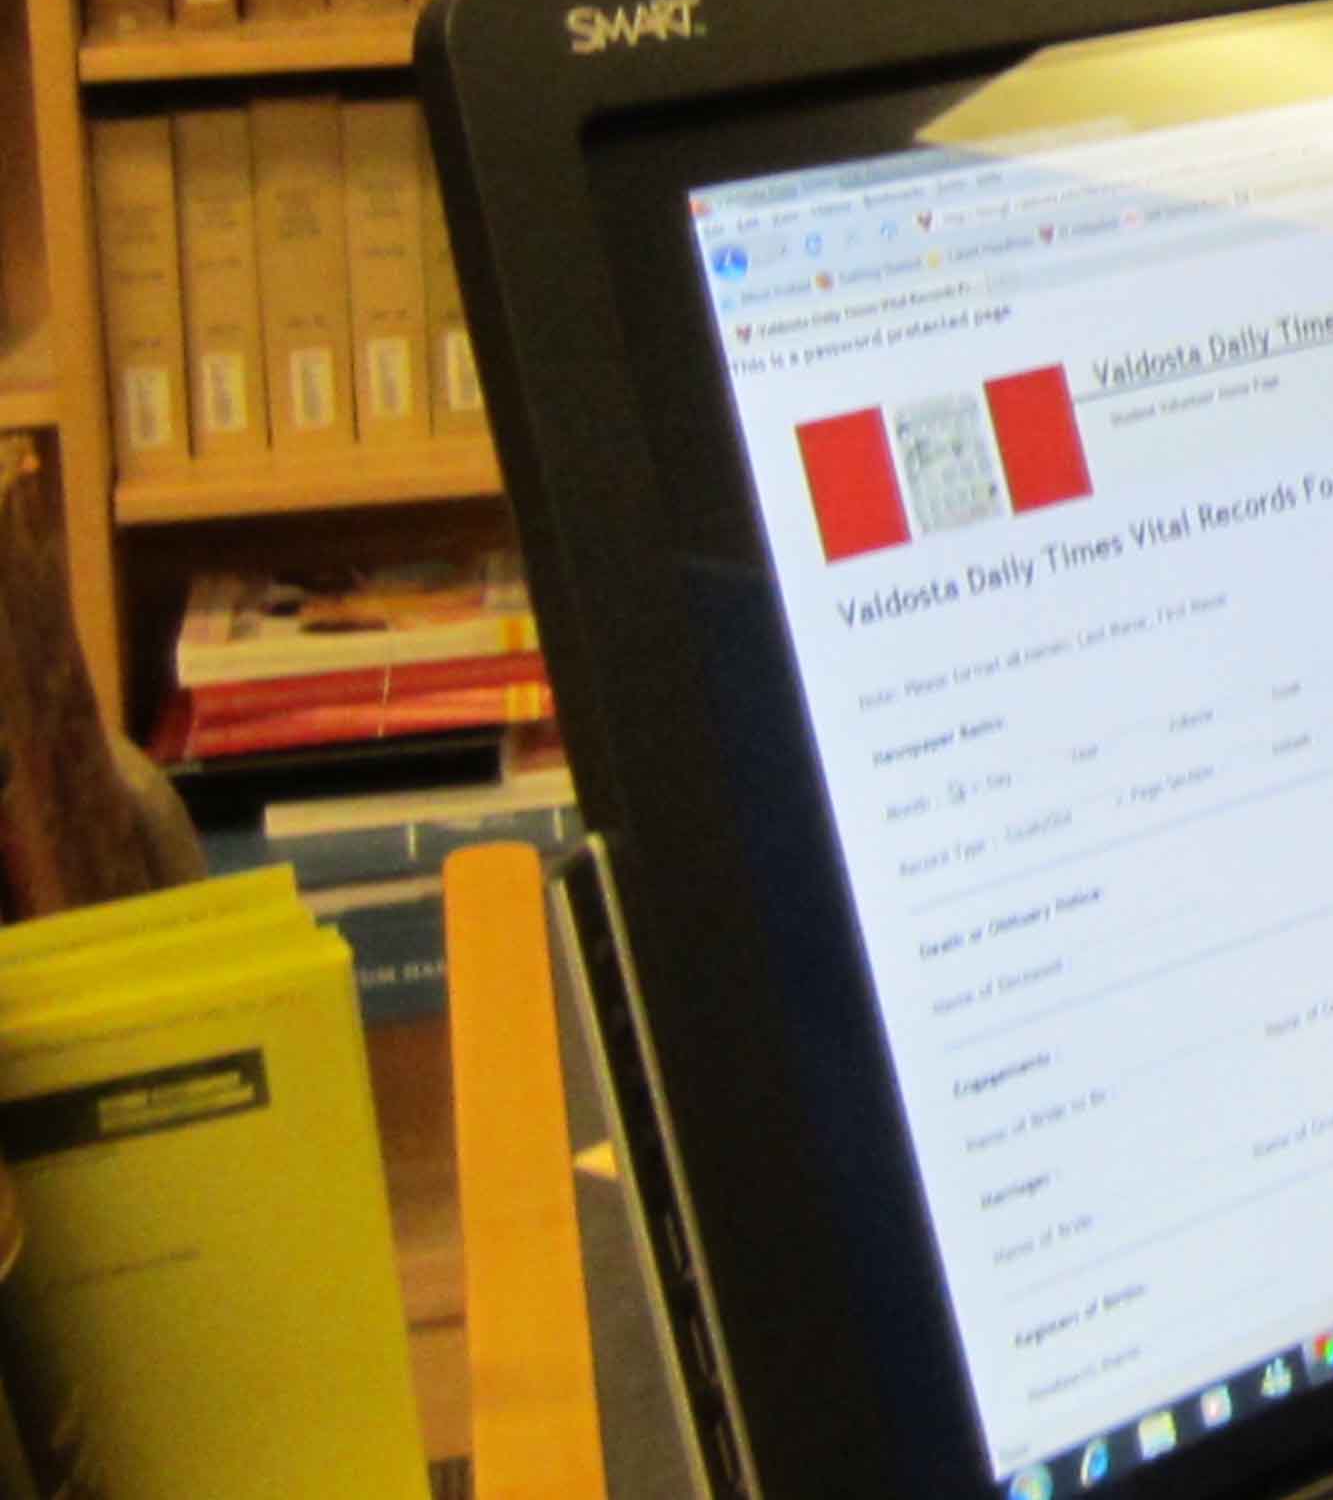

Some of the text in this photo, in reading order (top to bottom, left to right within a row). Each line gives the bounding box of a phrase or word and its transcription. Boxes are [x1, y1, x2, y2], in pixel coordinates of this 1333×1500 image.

[803, 328, 882, 363] password
[886, 311, 968, 344] protected
[1092, 346, 1201, 387] Valdosta
[1207, 326, 1275, 365] Daily
[837, 580, 959, 626] Valdosta
[965, 556, 1034, 594] Daily
[1043, 535, 1123, 571] Times
[1129, 509, 1190, 547] Vital
[1197, 484, 1296, 529] Records
